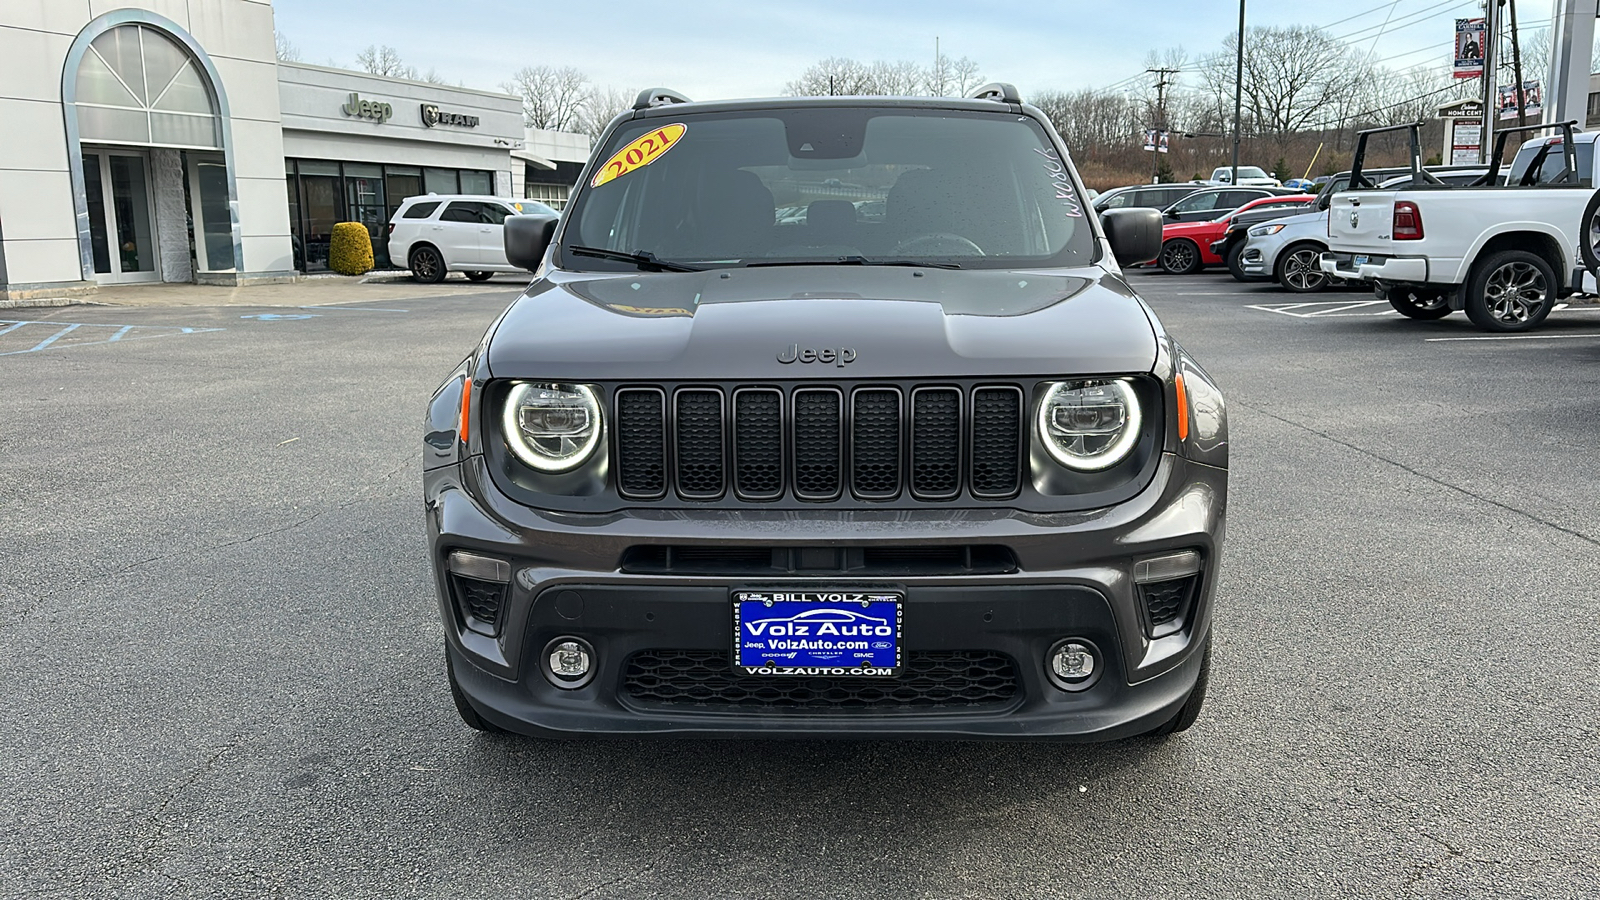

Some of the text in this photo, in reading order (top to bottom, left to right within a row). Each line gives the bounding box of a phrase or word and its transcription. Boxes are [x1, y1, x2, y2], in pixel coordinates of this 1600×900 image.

[342, 93, 393, 123] Jeep
[441, 113, 480, 127] RAM
[608, 130, 674, 178] 2021
[776, 343, 857, 368] Jeep
[773, 594, 864, 602] BILL VOLZ
[733, 602, 741, 666] WESTCHESTER
[745, 622, 892, 636] Volz Auto
[768, 639, 868, 650] VolzAuto.com
[745, 667, 892, 676] VOLZAUTO.COM
